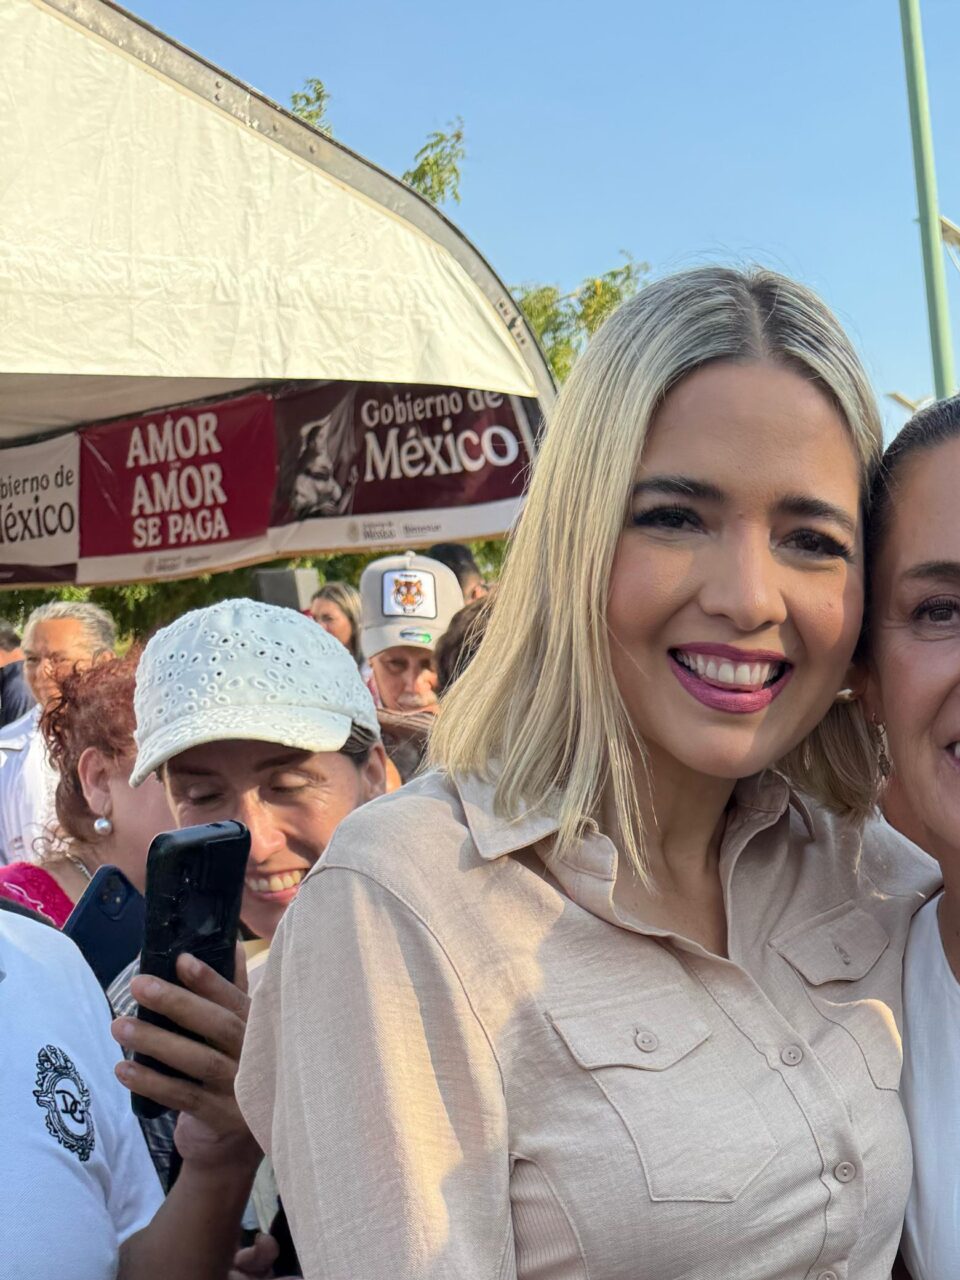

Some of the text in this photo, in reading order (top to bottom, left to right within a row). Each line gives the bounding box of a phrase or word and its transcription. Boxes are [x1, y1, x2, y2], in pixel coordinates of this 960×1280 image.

[361, 391, 463, 428] Gobierno
[126, 412, 223, 469] AMOR
[364, 417, 519, 482] México
[54, 464, 74, 488] de
[131, 462, 228, 517] AMOR
[132, 507, 230, 548] SE PAGA
